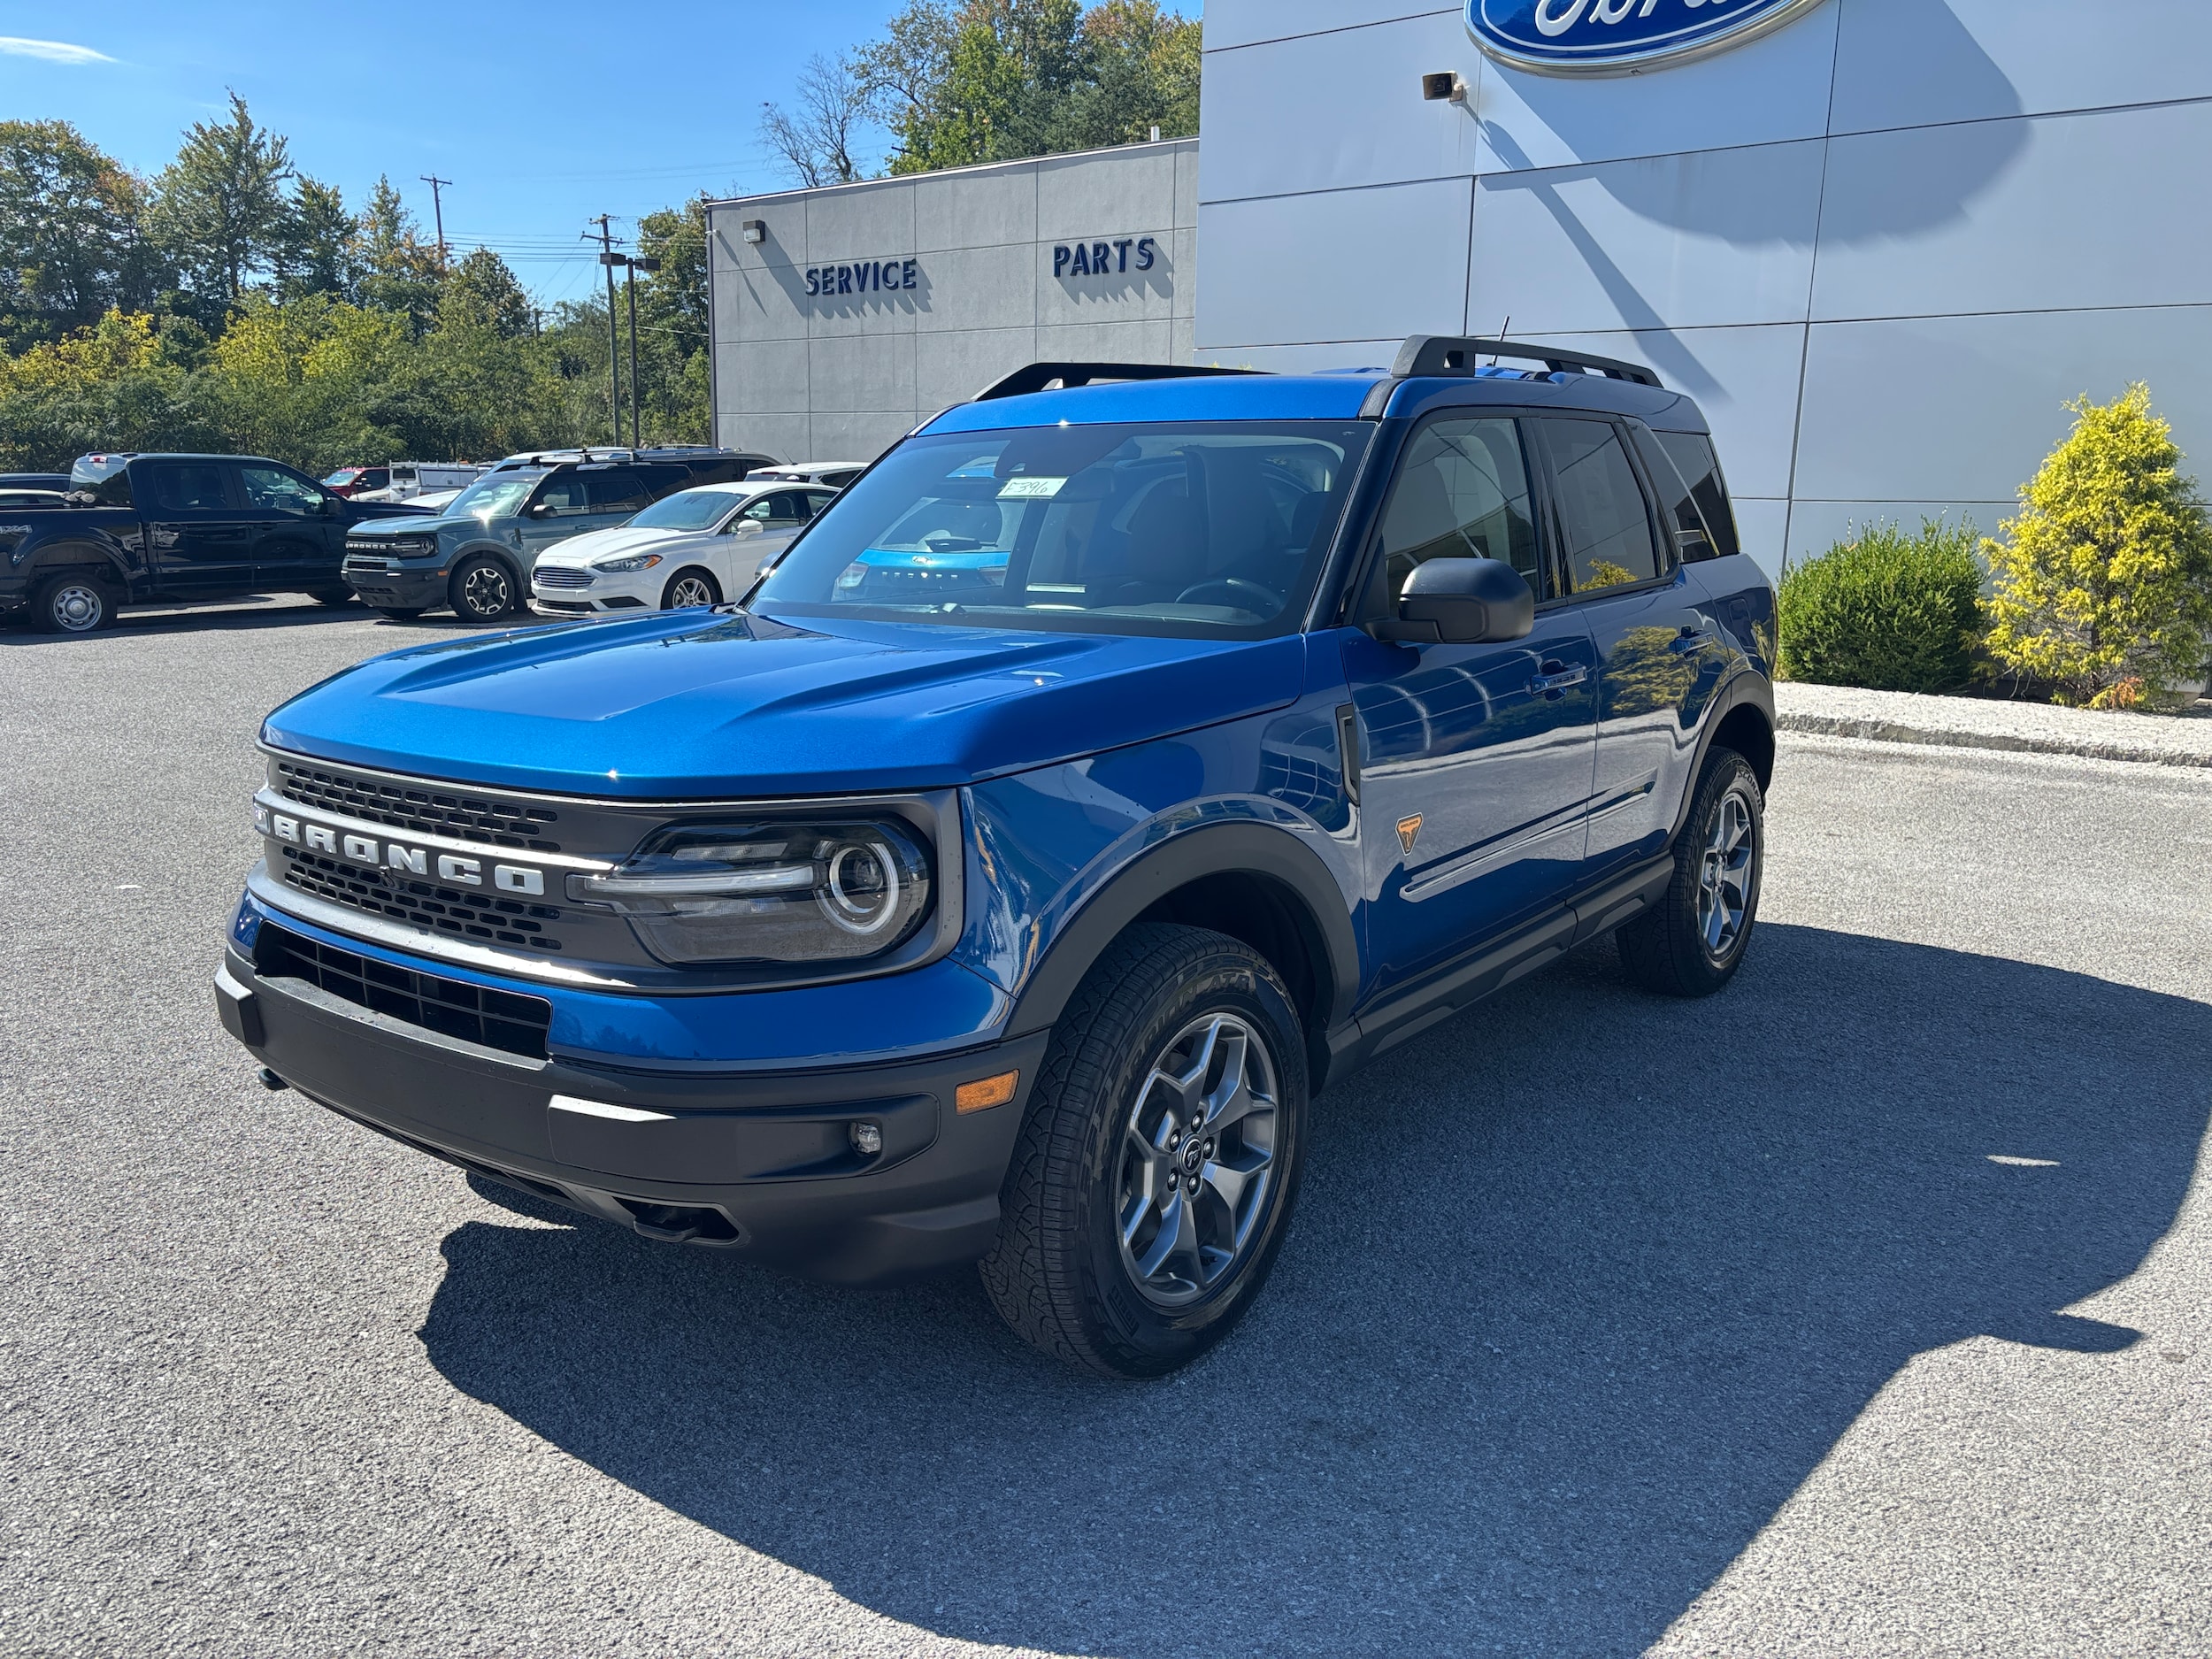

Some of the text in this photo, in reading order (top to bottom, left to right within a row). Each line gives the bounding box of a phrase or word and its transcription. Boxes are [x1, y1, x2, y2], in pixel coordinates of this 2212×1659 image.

[805, 257, 917, 296] SERVICE
[1053, 238, 1155, 277] PARTS
[273, 814, 545, 895] BRONCO
